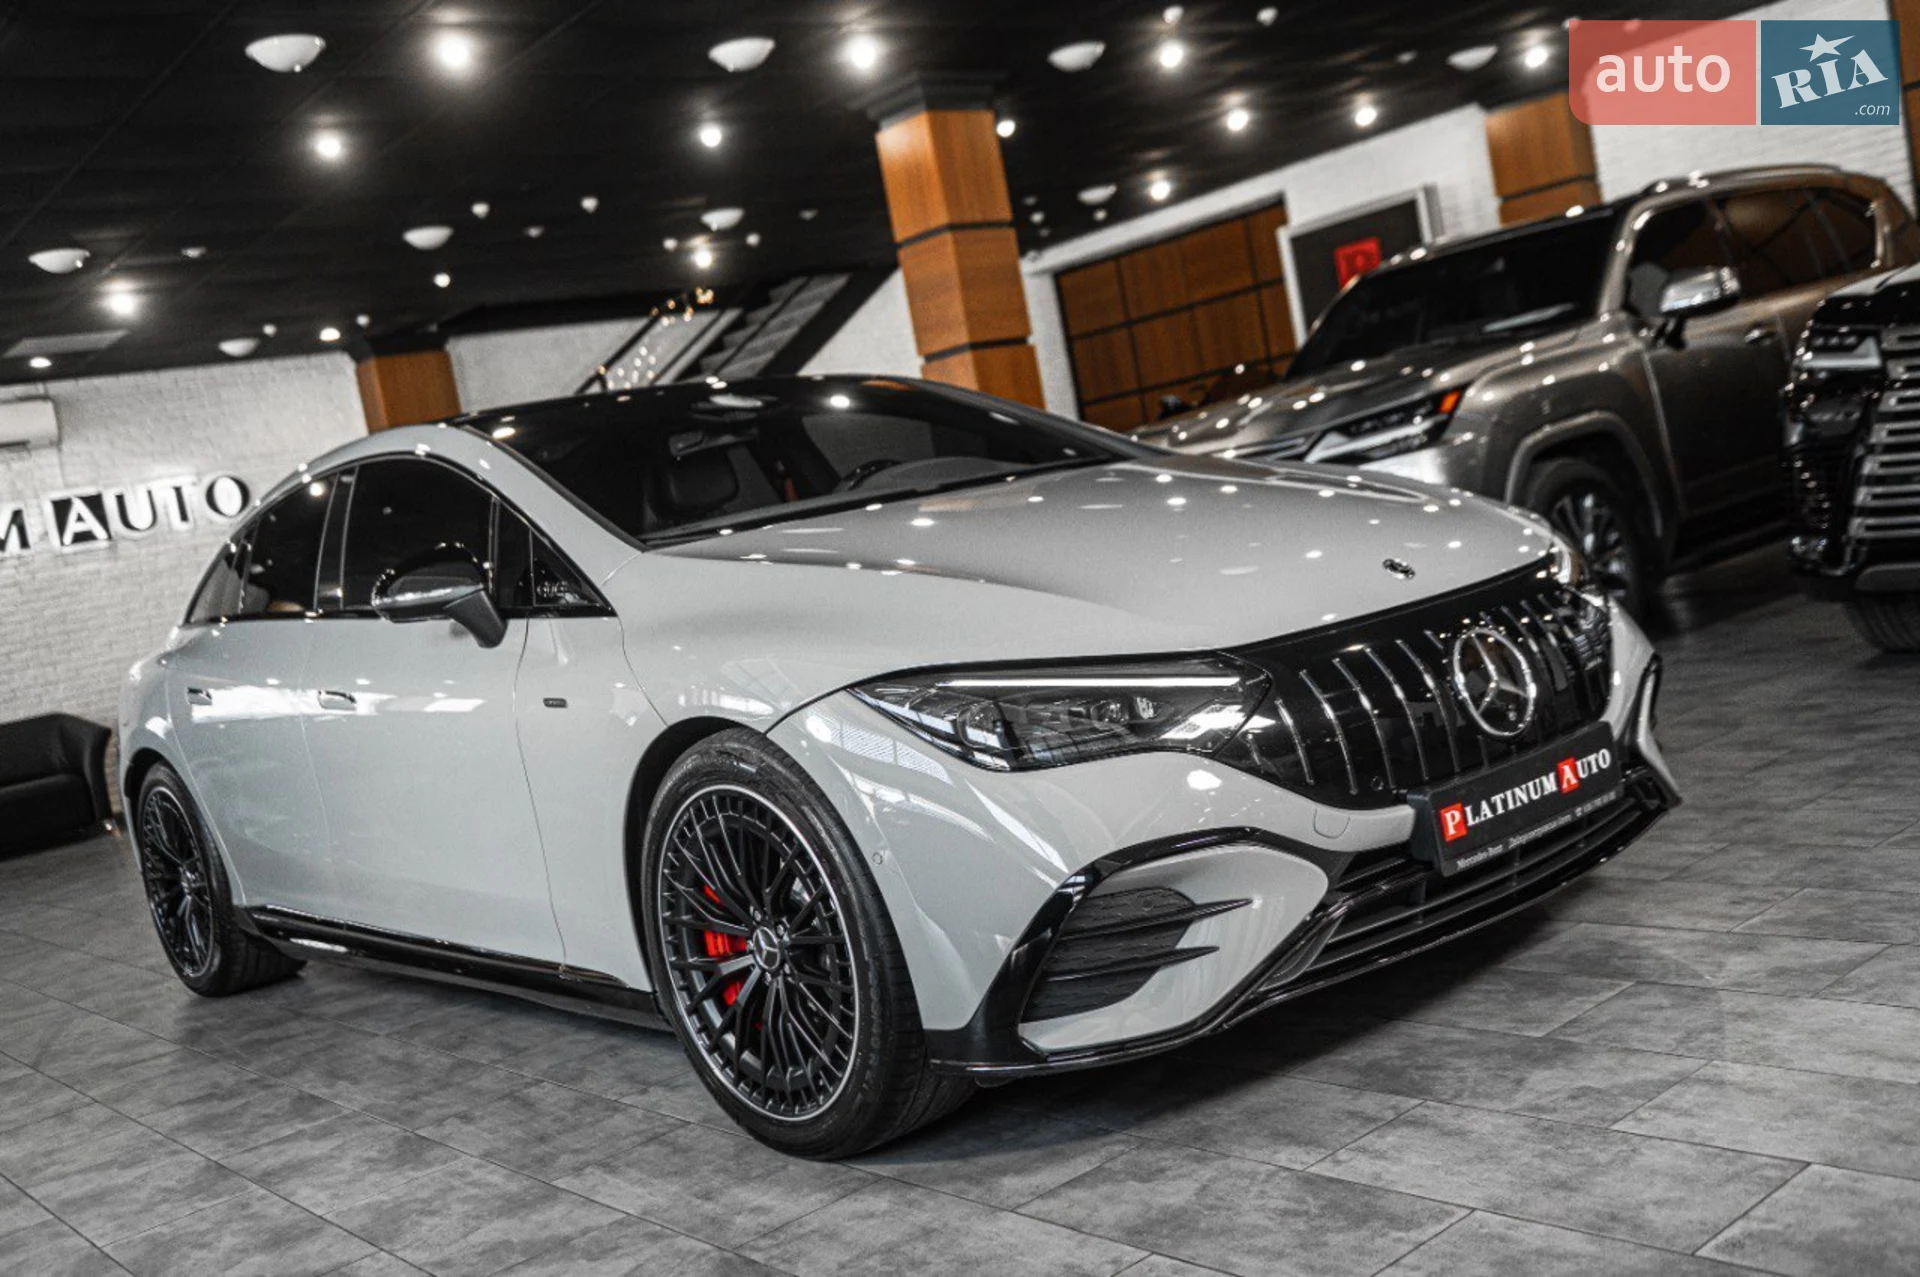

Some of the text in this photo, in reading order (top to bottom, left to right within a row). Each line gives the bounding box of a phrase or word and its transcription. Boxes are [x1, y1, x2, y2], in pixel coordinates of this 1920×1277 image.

[51, 475, 250, 547] AUTO
[1442, 770, 1558, 838] PLATINUM
[1559, 748, 1612, 791] AUTO
